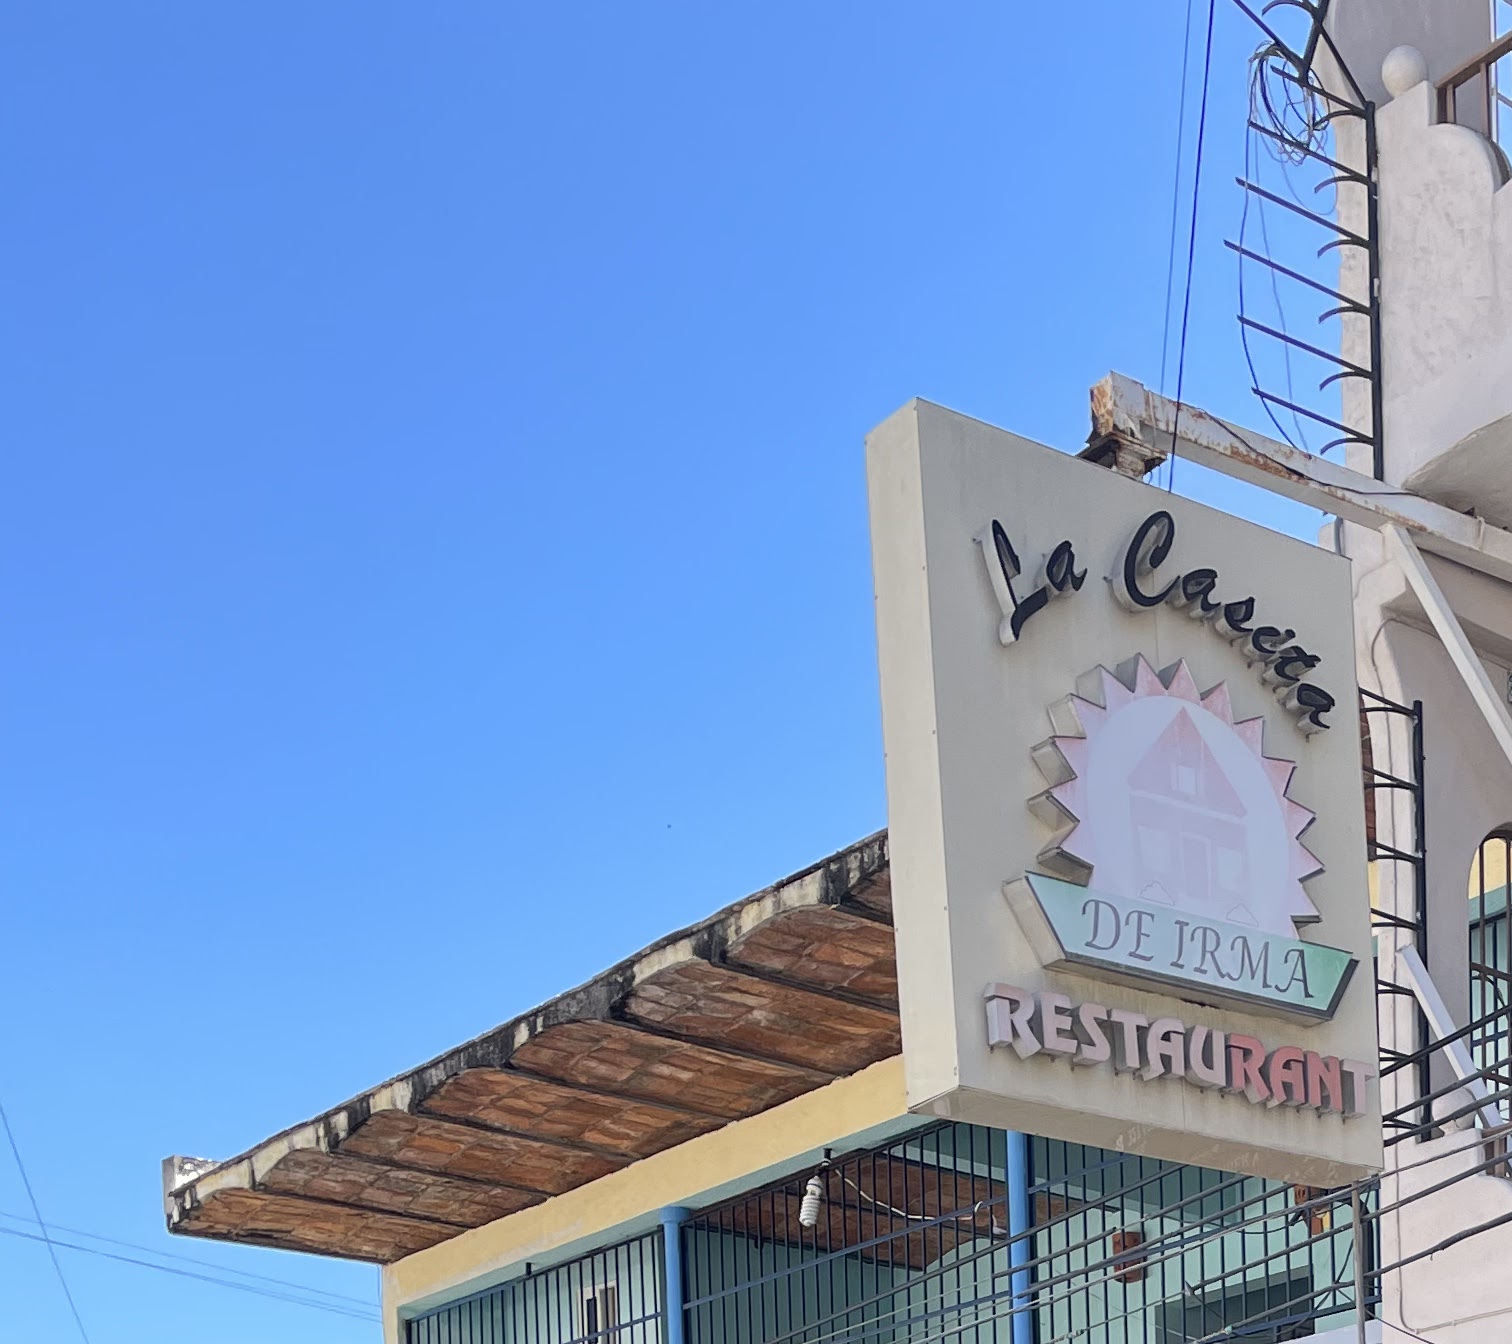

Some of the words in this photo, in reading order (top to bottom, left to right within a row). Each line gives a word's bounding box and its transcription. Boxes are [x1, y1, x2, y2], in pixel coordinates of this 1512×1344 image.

[986, 518, 1088, 643] La
[1120, 510, 1336, 732] Casita
[1081, 898, 1156, 962] DE
[1169, 917, 1315, 999] IRMA
[983, 982, 1377, 1119] RESTAURANT
